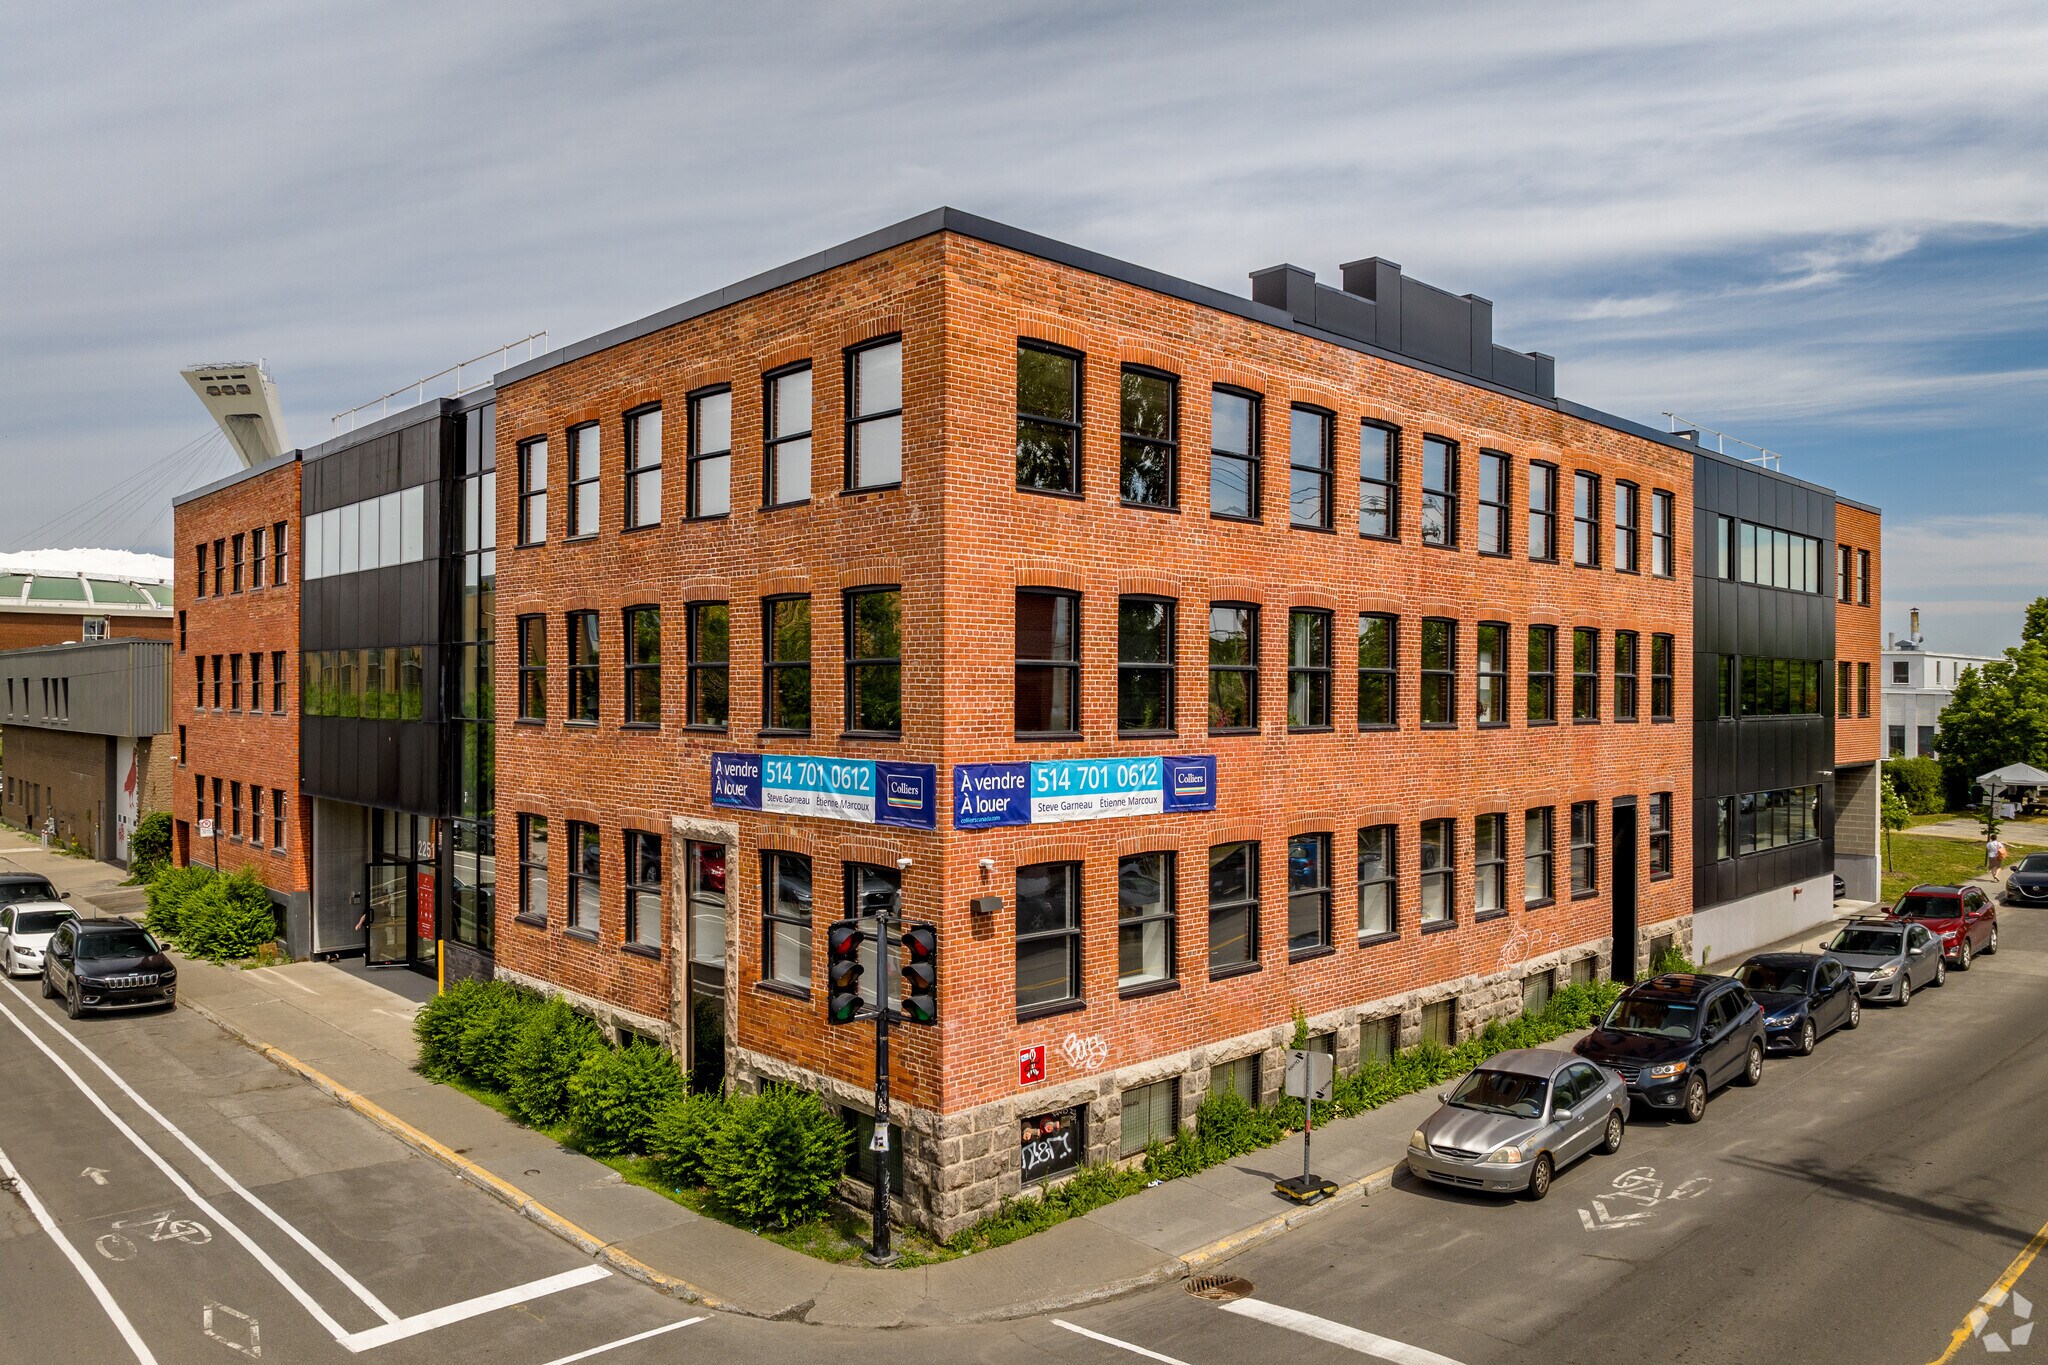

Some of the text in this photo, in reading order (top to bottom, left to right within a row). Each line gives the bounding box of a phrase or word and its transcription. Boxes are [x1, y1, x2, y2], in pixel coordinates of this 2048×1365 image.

[715, 756, 758, 778] À vendre
[766, 761, 870, 791] 514 701 0612
[1037, 763, 1158, 792] 514 701 0612
[715, 775, 748, 796] À louer
[890, 781, 919, 796] Colliers
[961, 769, 1025, 792] À vendre
[1178, 773, 1203, 784] Colliers
[766, 792, 783, 803] Steve
[783, 794, 810, 805] Garneau
[816, 794, 839, 809] Étienne
[839, 799, 870, 811] Marcoux
[960, 792, 1010, 814] À louer
[1037, 802, 1059, 813] Steve
[1060, 801, 1093, 811] Garneau
[1099, 796, 1126, 808] Étienne
[1127, 797, 1158, 806] Marcoux
[418, 840, 435, 859] 2251
